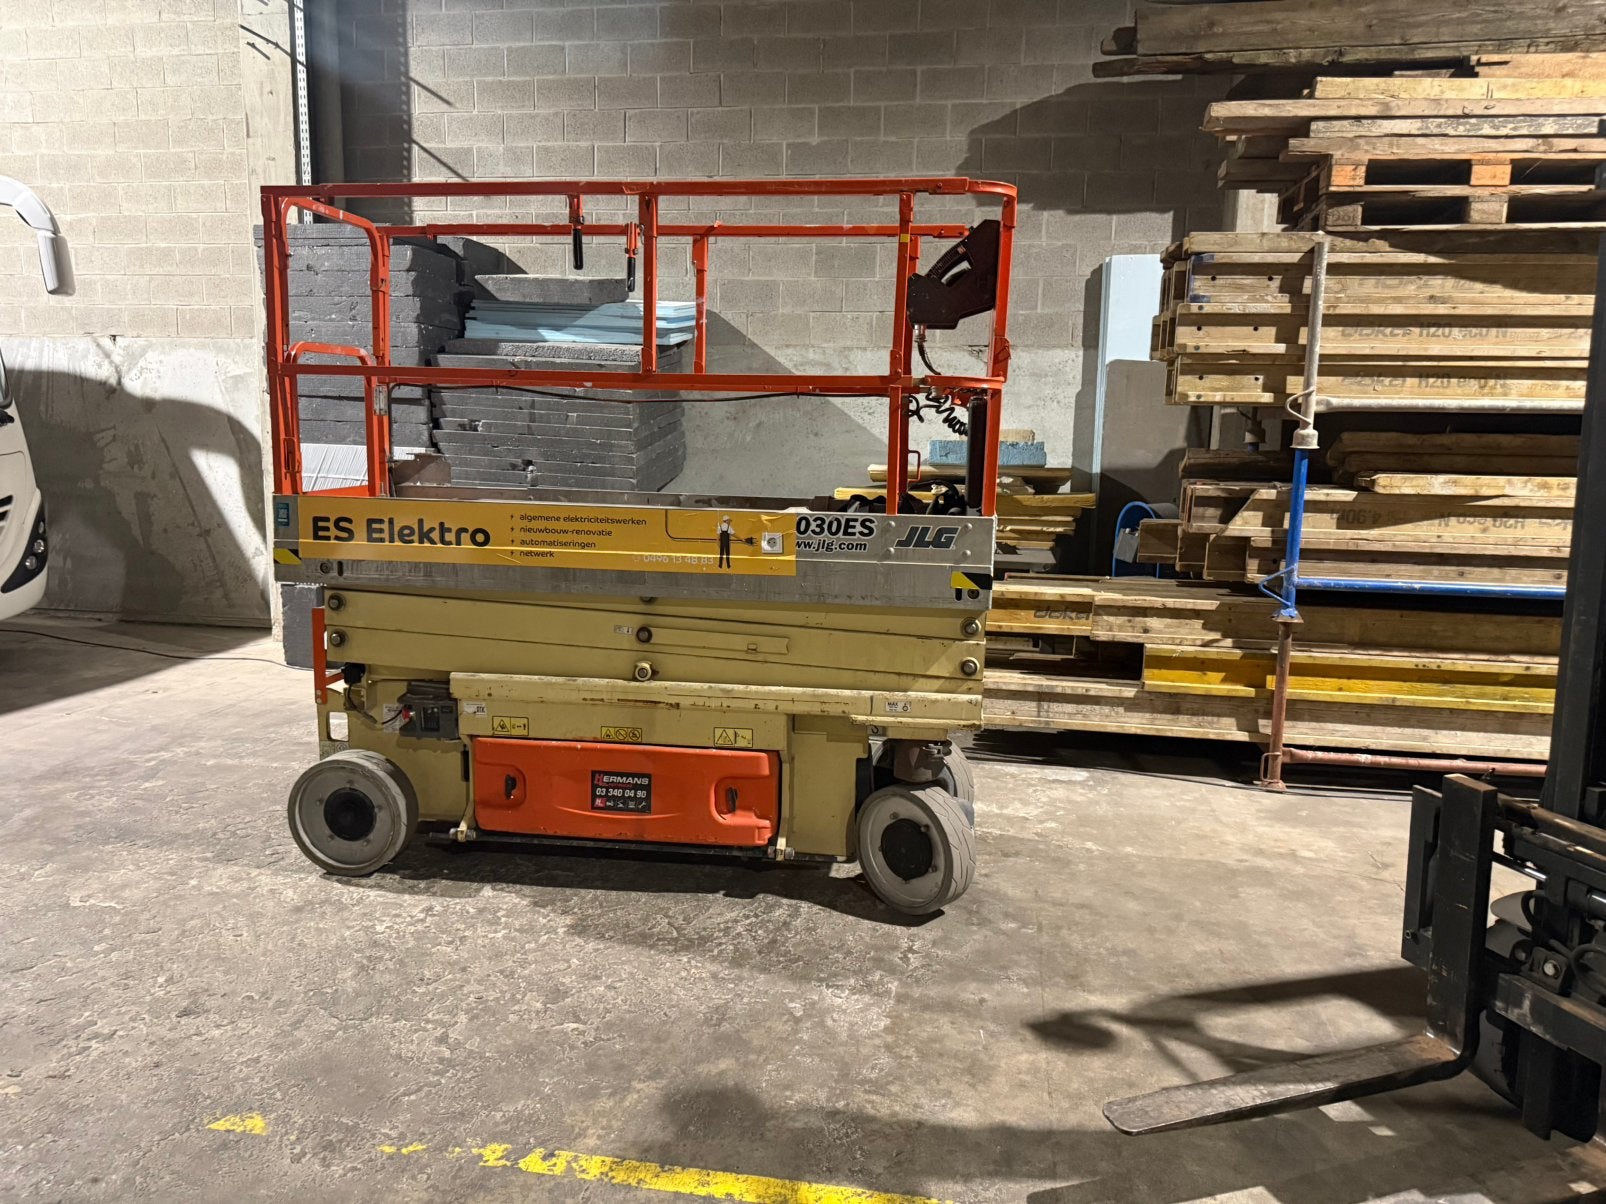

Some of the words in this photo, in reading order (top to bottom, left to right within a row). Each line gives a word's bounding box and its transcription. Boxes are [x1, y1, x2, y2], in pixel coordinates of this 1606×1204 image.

[1419, 321, 1453, 337] H20
[1458, 325, 1490, 338] eco
[1418, 372, 1451, 389] H20
[1456, 375, 1488, 391] eco
[519, 513, 561, 524] algemene
[562, 514, 647, 526] elektriciteitswerken
[312, 515, 355, 543] ES
[366, 517, 491, 548] Elektro
[519, 526, 613, 537] nieuwbouw-renovatie
[796, 515, 876, 538] 030ES
[519, 538, 596, 549] automatiseringen
[894, 526, 960, 549] JLG
[519, 550, 555, 558] netwerk
[595, 774, 649, 785] HERMANS
[596, 787, 606, 796] 03
[608, 788, 623, 797] 340
[624, 789, 635, 798] 04
[636, 790, 647, 799] 90
